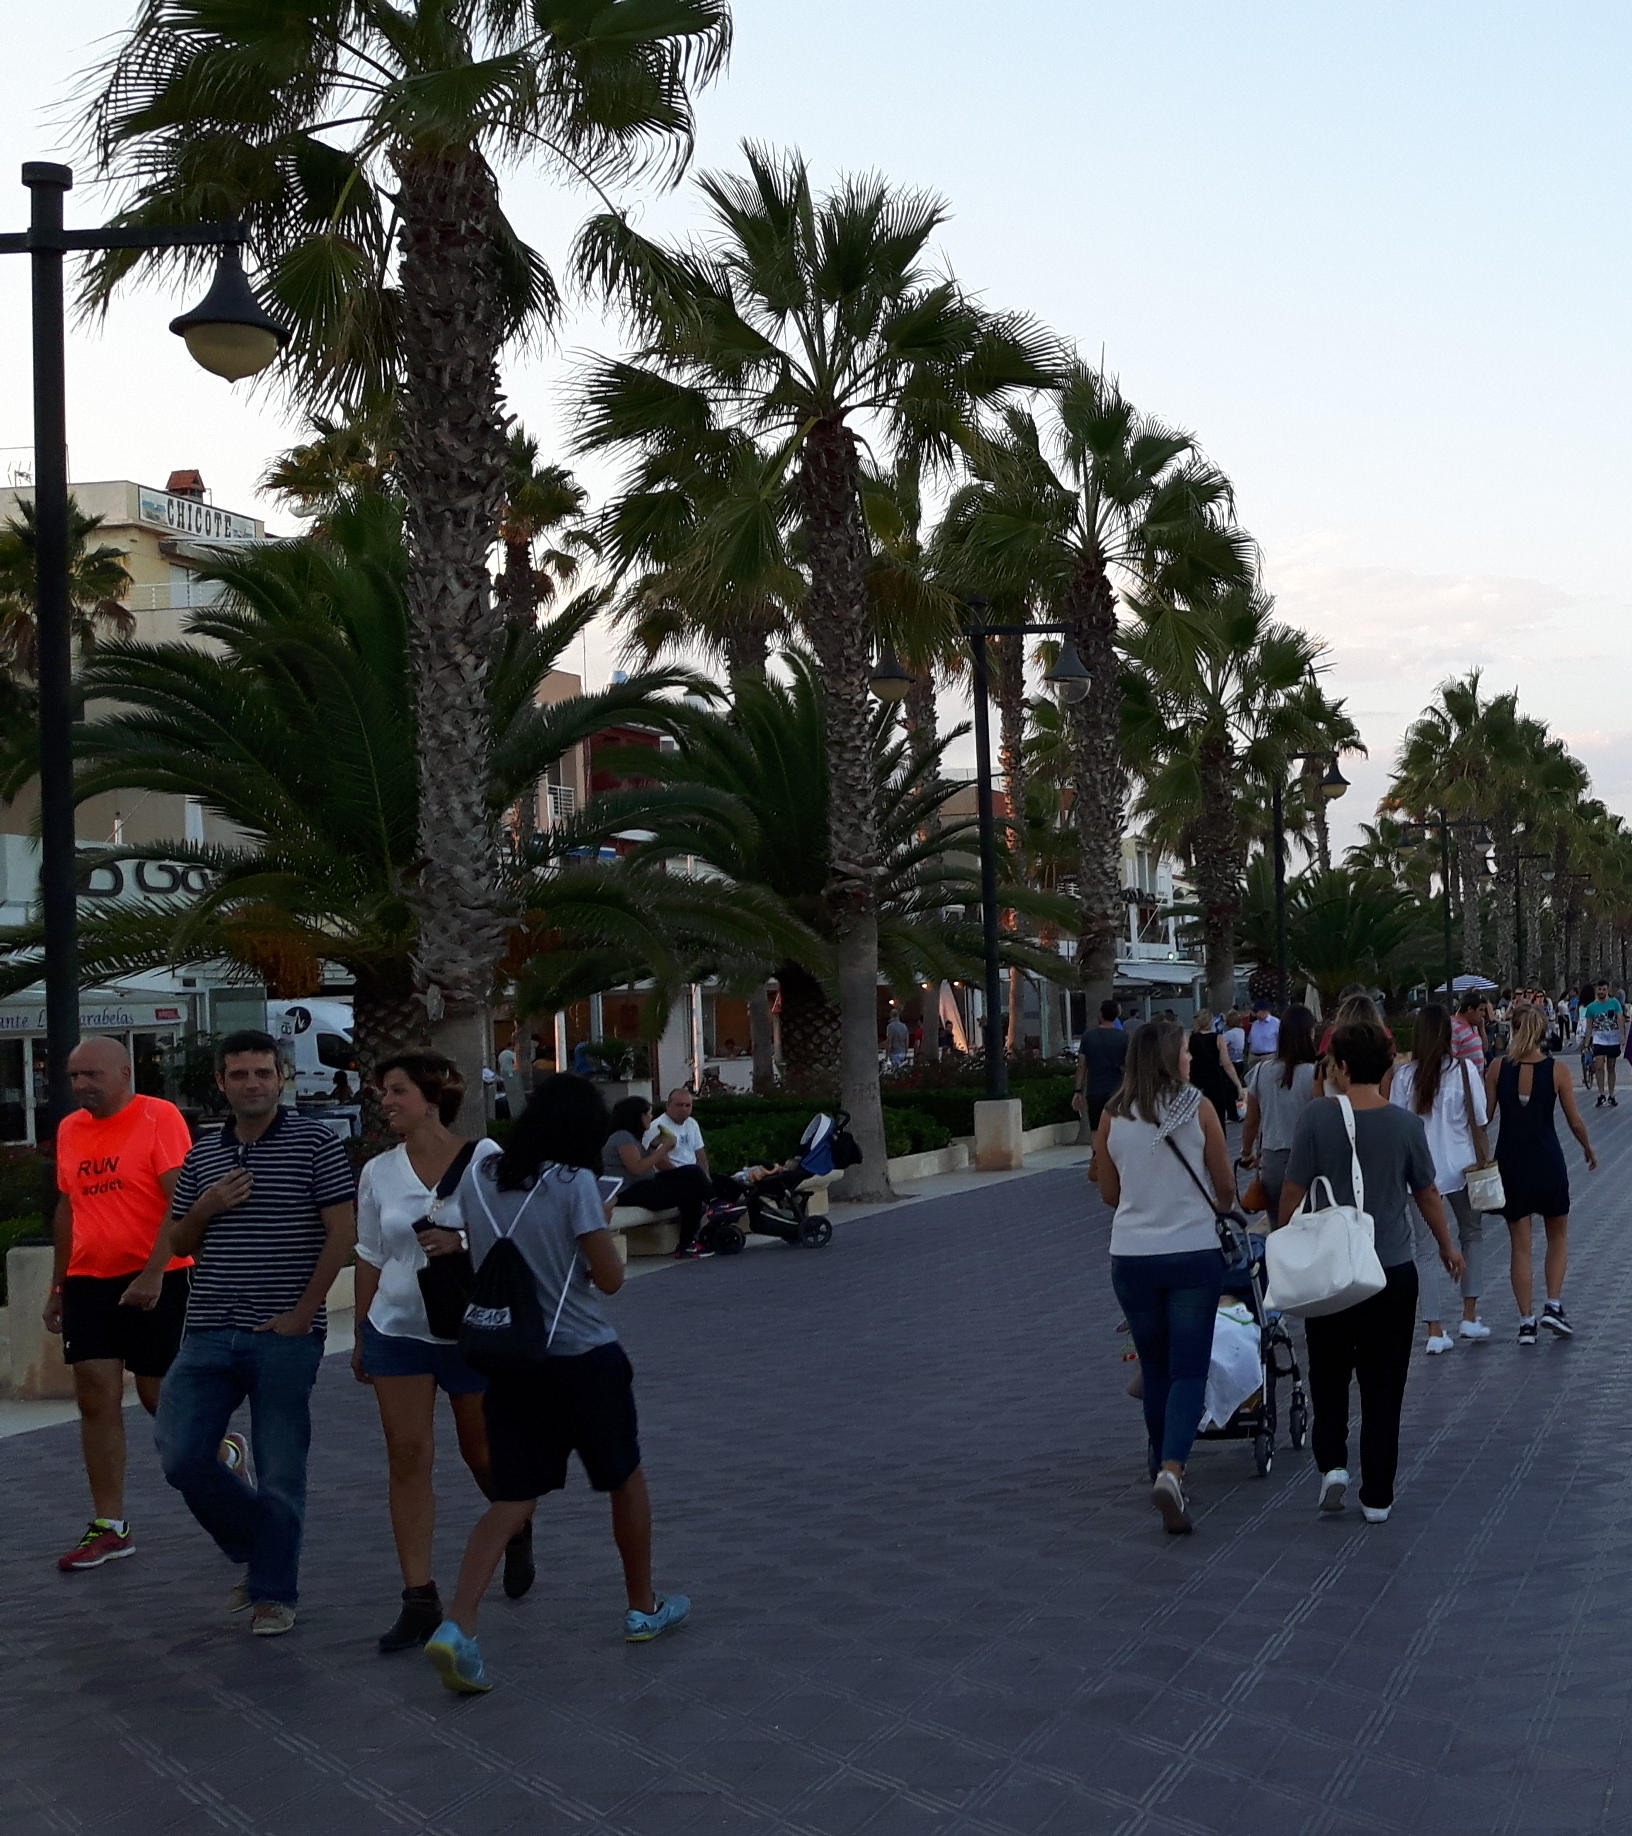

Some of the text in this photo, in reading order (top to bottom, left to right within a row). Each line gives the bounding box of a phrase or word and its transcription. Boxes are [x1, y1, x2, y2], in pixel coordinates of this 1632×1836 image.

[167, 498, 232, 538] CHICOTE
[79, 1007, 134, 1026] arabelas
[77, 1155, 120, 1178] RUN
